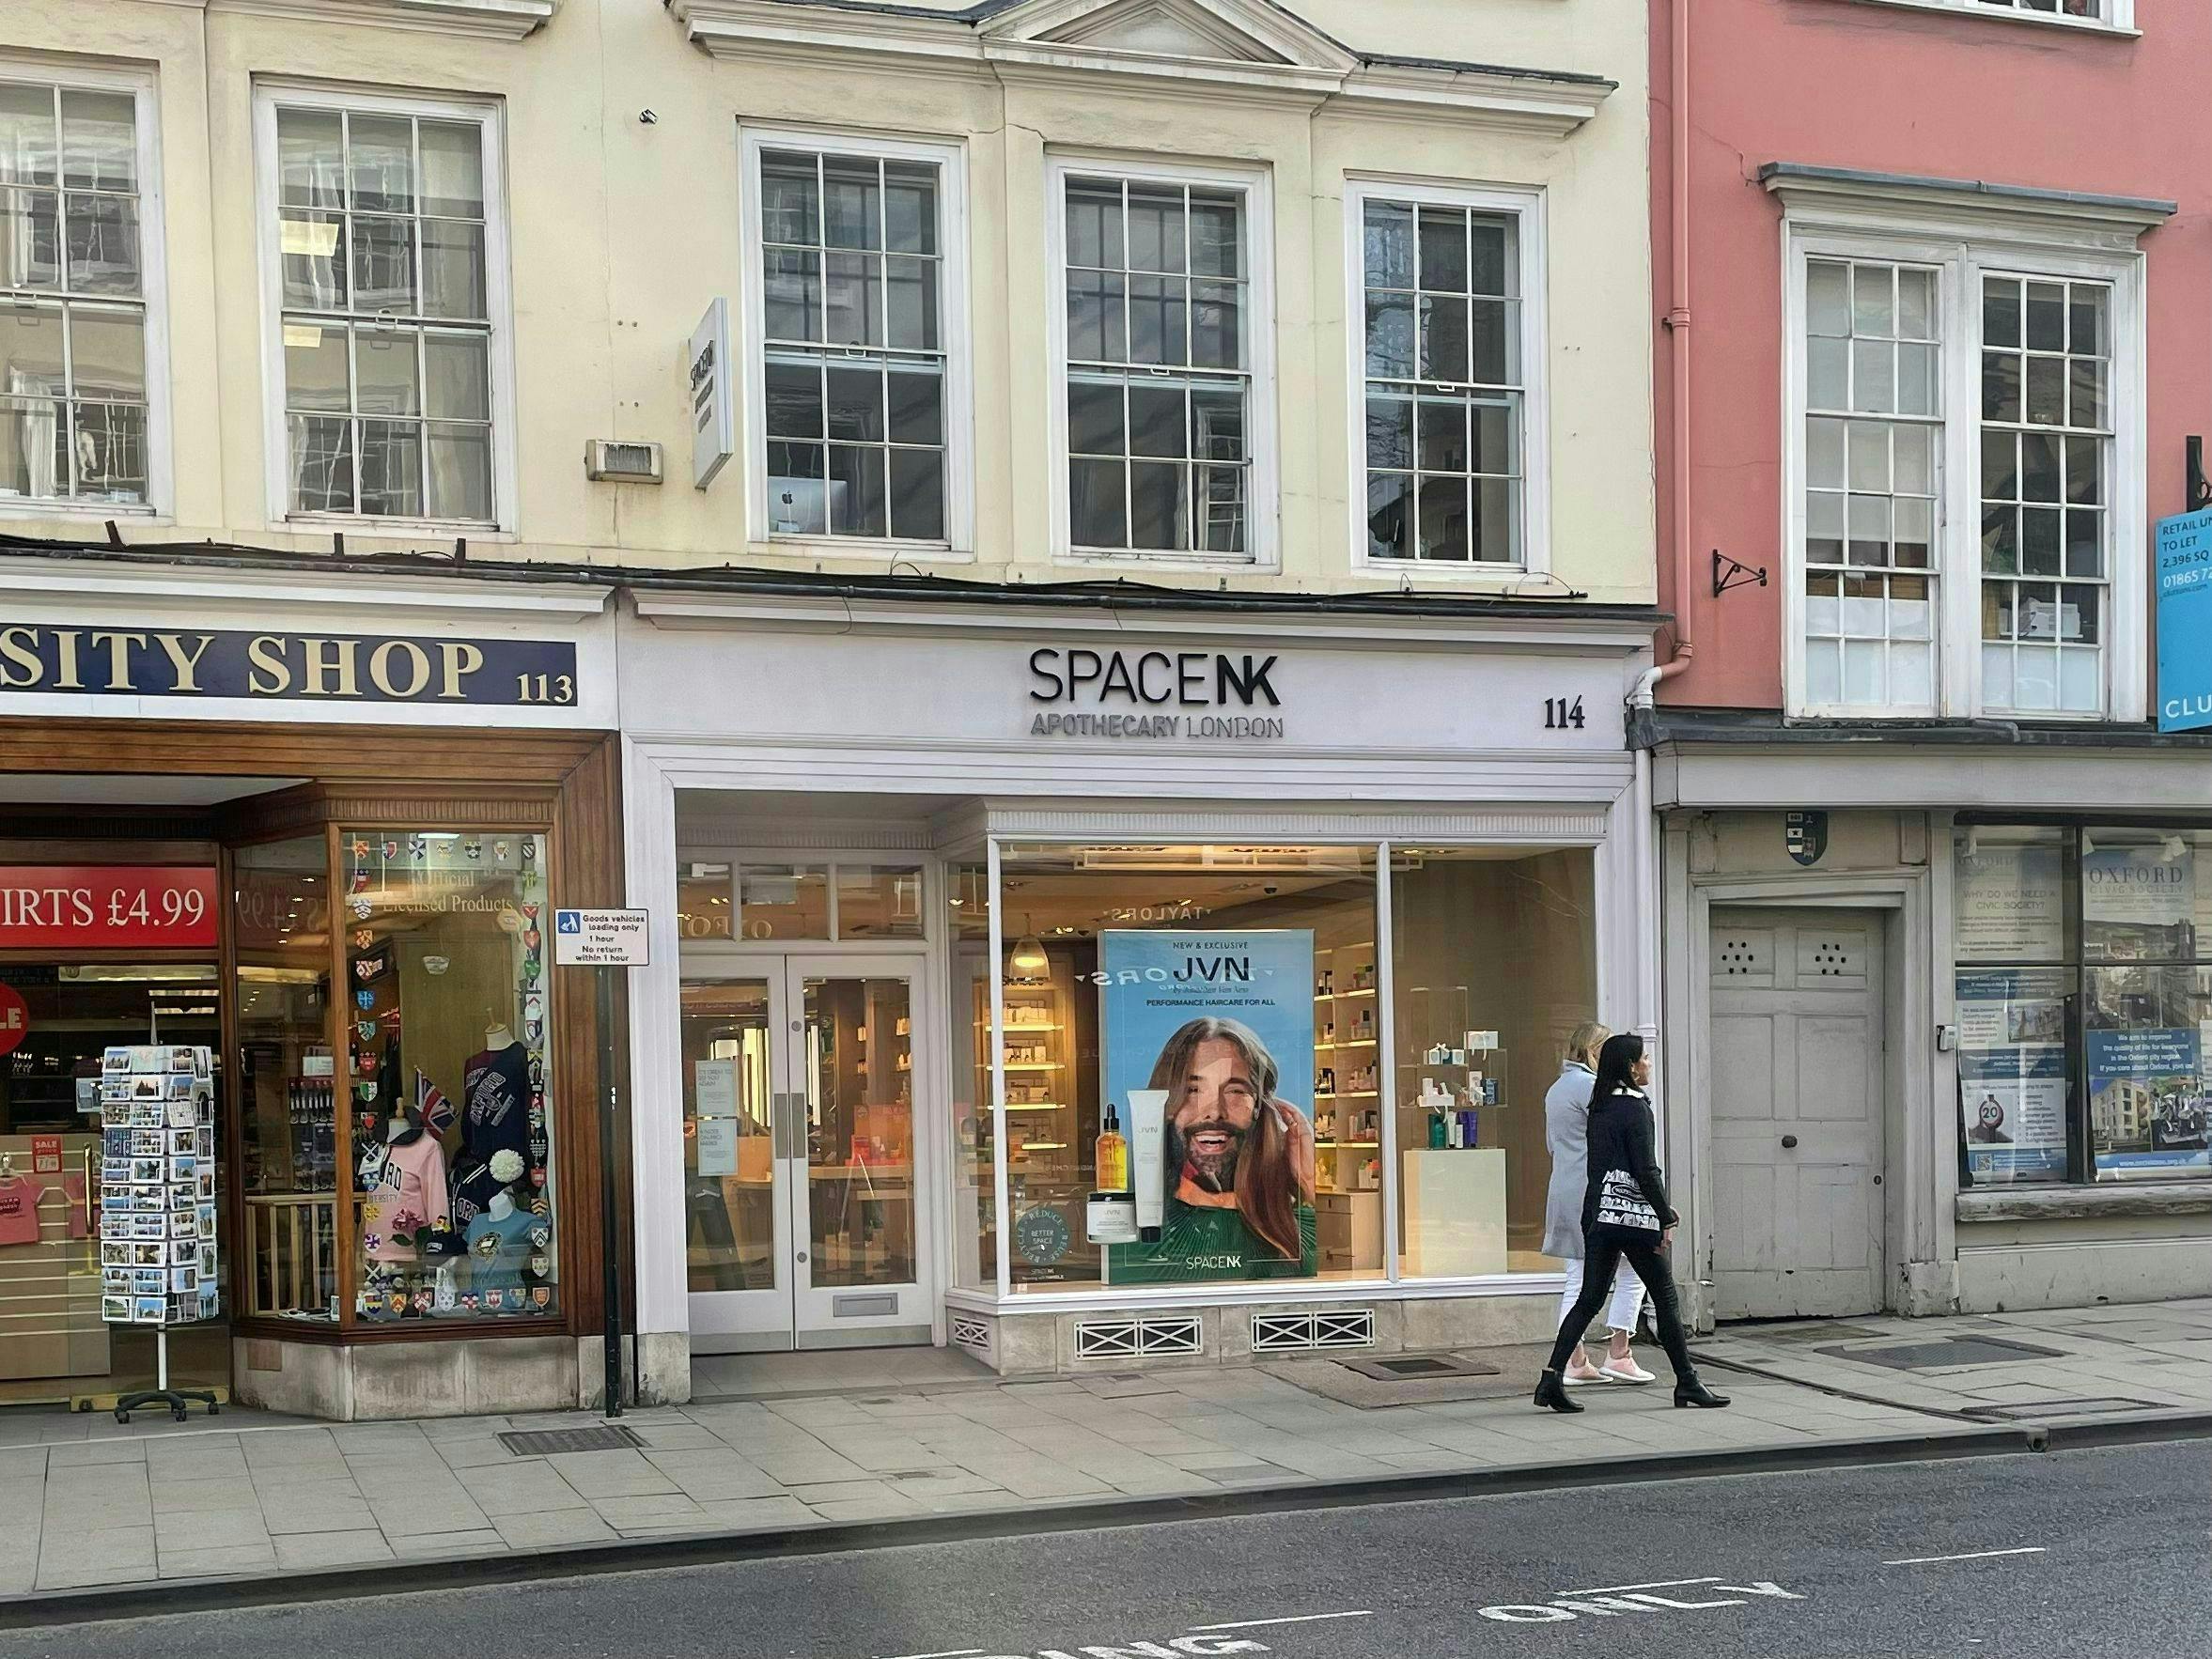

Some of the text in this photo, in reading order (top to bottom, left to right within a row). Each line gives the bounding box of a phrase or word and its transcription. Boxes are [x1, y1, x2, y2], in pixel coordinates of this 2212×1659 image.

[2163, 520, 2197, 535] RETAIL
[2163, 535, 2198, 552] TO LET
[2194, 550, 2209, 563] SQ
[2163, 569, 2199, 588] 01865
[0, 627, 484, 698] SITY SHOP
[517, 673, 573, 703] 113
[1545, 694, 1585, 728] 114
[1031, 712, 1284, 738] APOTHECARY LONDON
[2089, 866, 2183, 884] OXFORD
[0, 888, 205, 926] IRTS £4.99
[382, 894, 513, 912] Licensed Products
[583, 914, 646, 923] Goods vehicles
[588, 923, 639, 932] loading only
[583, 945, 595, 954] No
[1173, 941, 1249, 950] NEW & EXCLUSIVE
[1173, 956, 1249, 983] JVN
[1982, 1107, 1999, 1119] 20
[35, 1140, 58, 1149] SALE
[1028, 1209, 1063, 1226] REDUCE
[1051, 1234, 1069, 1262] REUSE
[1478, 1581, 1808, 1622] ONLY
